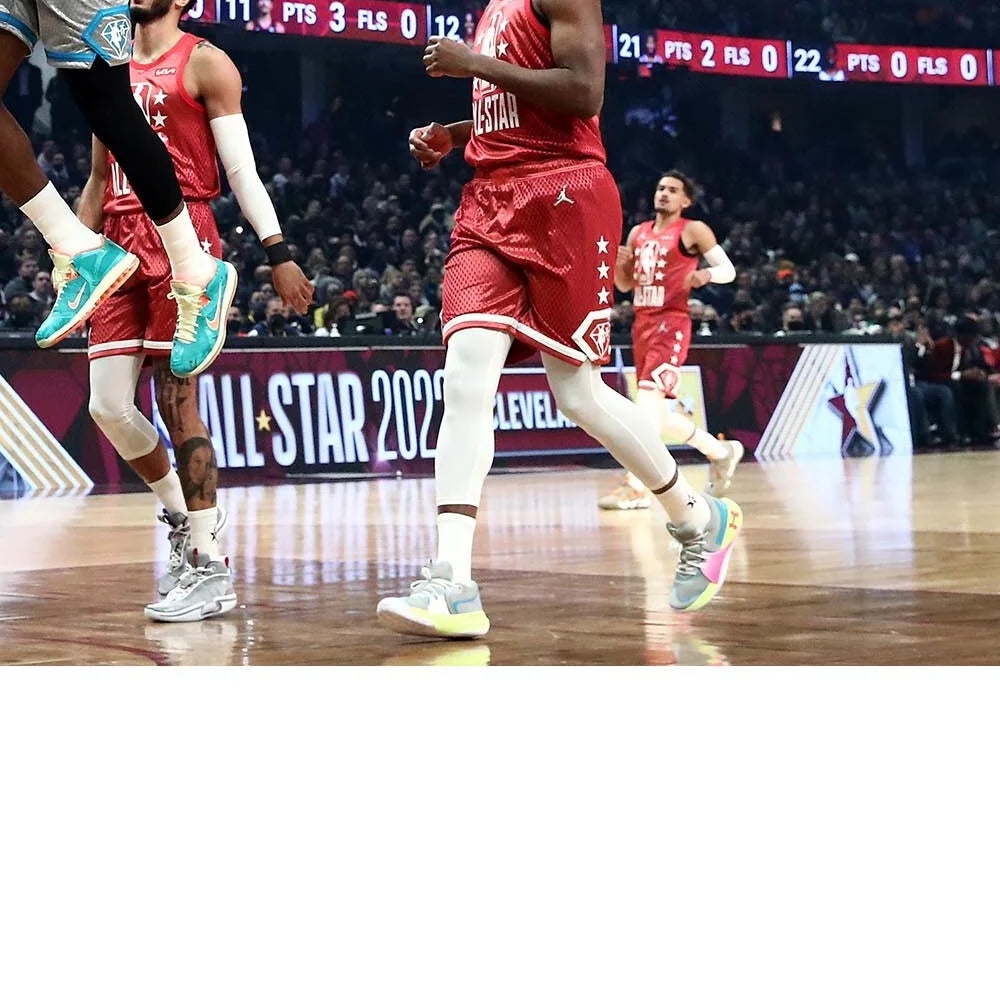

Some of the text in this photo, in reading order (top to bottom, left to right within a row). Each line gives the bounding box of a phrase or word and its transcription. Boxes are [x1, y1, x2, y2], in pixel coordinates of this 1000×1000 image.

[282, 2, 317, 25] PTS
[329, 1, 346, 33] 3
[357, 10, 388, 31] FLS
[400, 9, 417, 40] 0
[435, 15, 460, 41] 12
[619, 33, 778, 73] 21 PTS 2 FLS 0
[793, 49, 978, 81] 22 PTS 0 FLS 0
